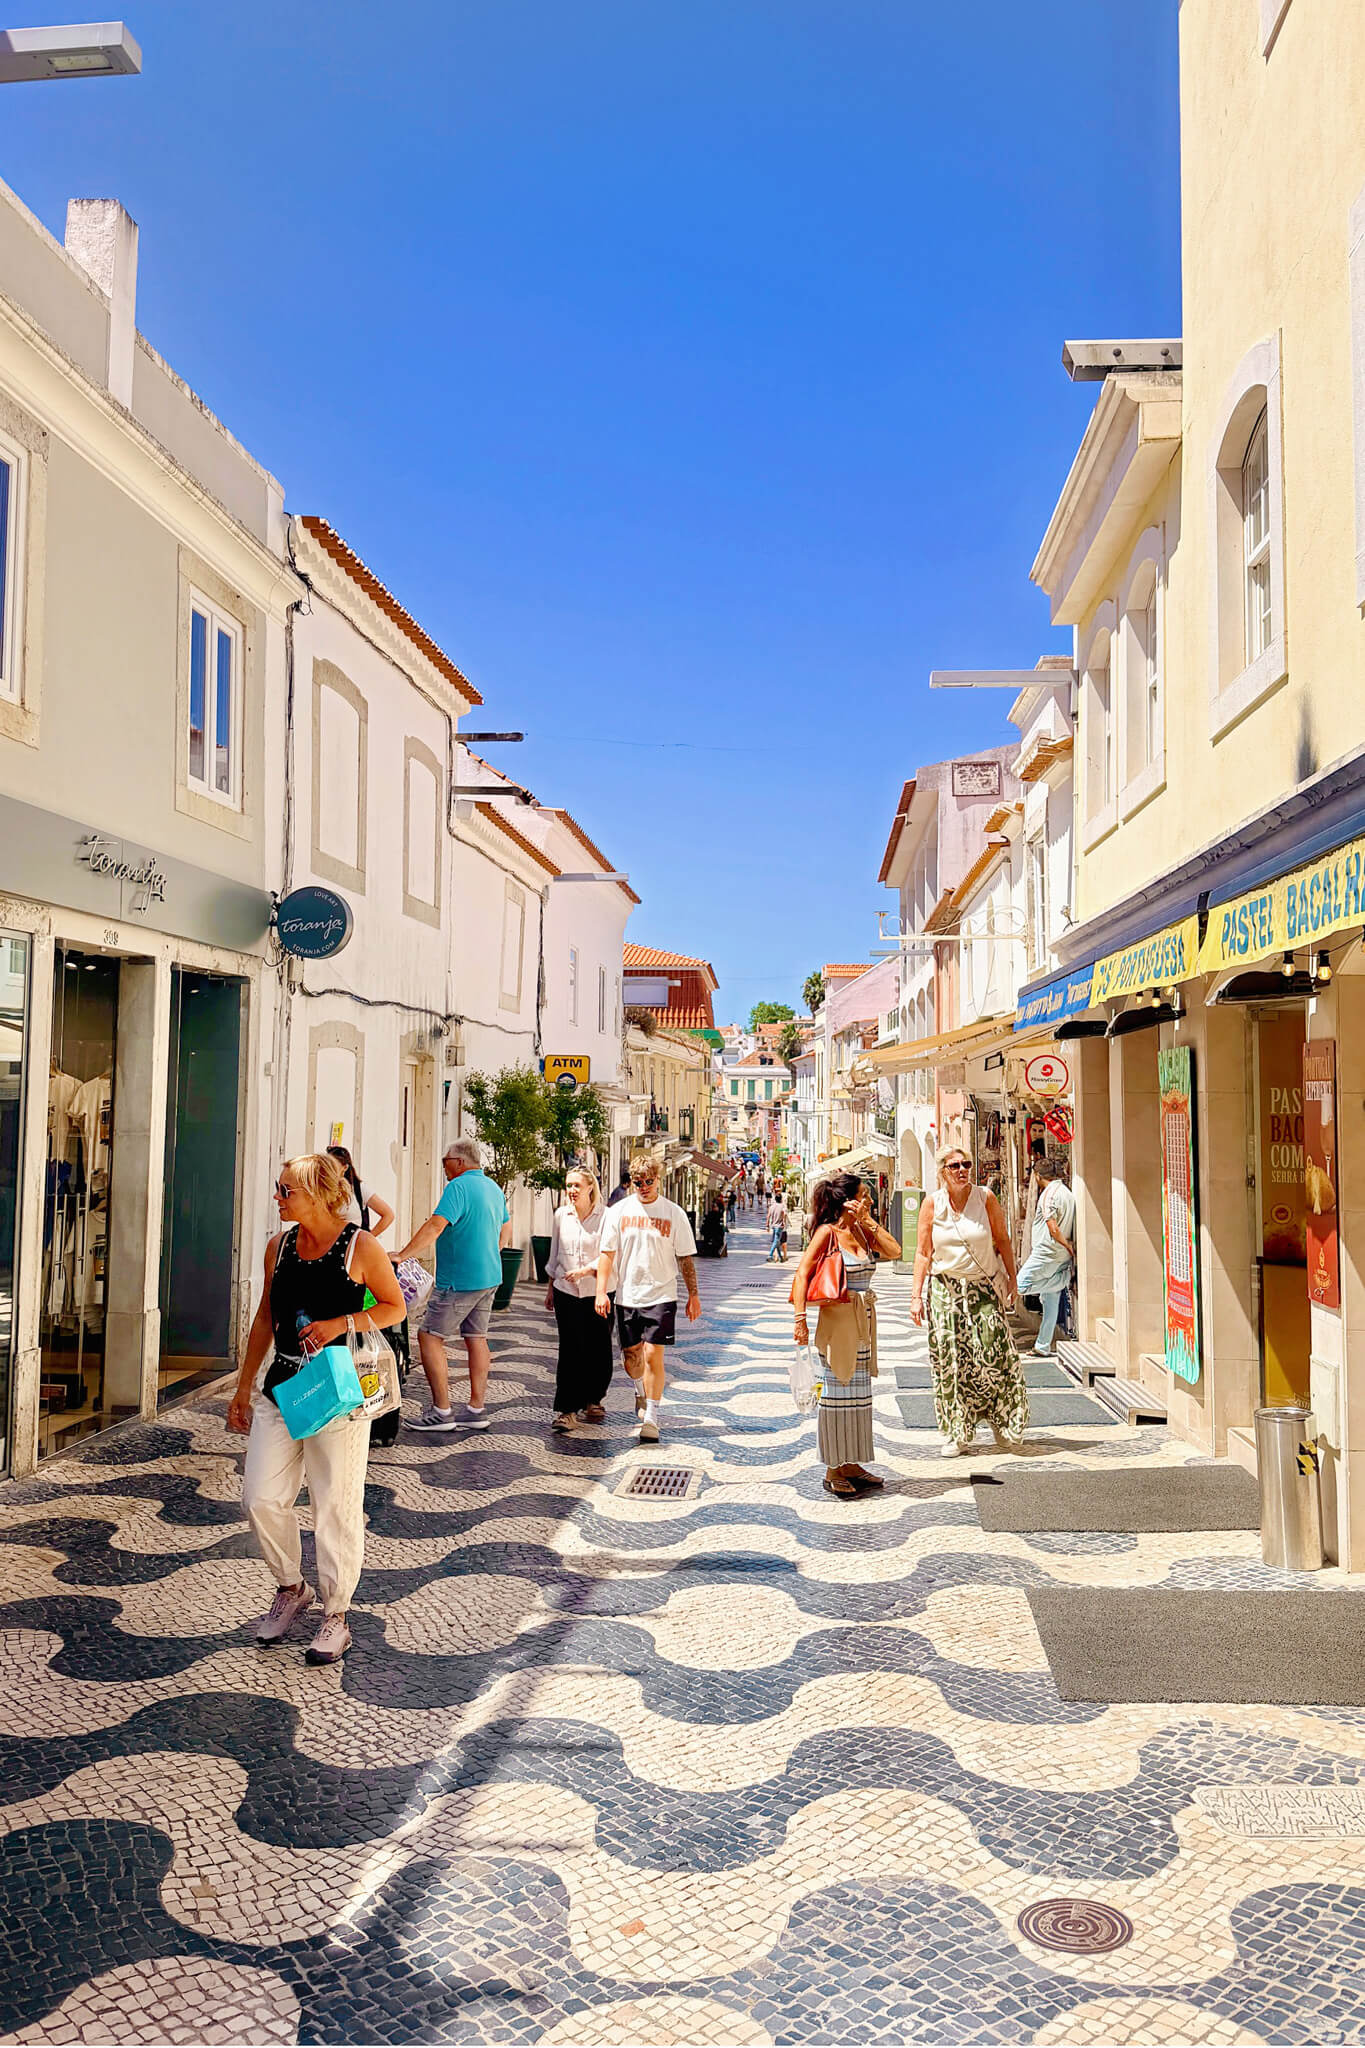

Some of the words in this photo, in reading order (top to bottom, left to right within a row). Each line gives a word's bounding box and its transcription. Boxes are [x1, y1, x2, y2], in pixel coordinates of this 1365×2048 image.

[83, 834, 167, 916] toranja
[314, 890, 330, 900] LOVE
[281, 914, 344, 940] toranja
[1221, 894, 1273, 961] PASTEL
[552, 1058, 583, 1068] ATM
[1270, 1087, 1305, 1114] PAS
[1271, 1170, 1298, 1183] SERRA
[621, 1215, 672, 1238] PANTERA
